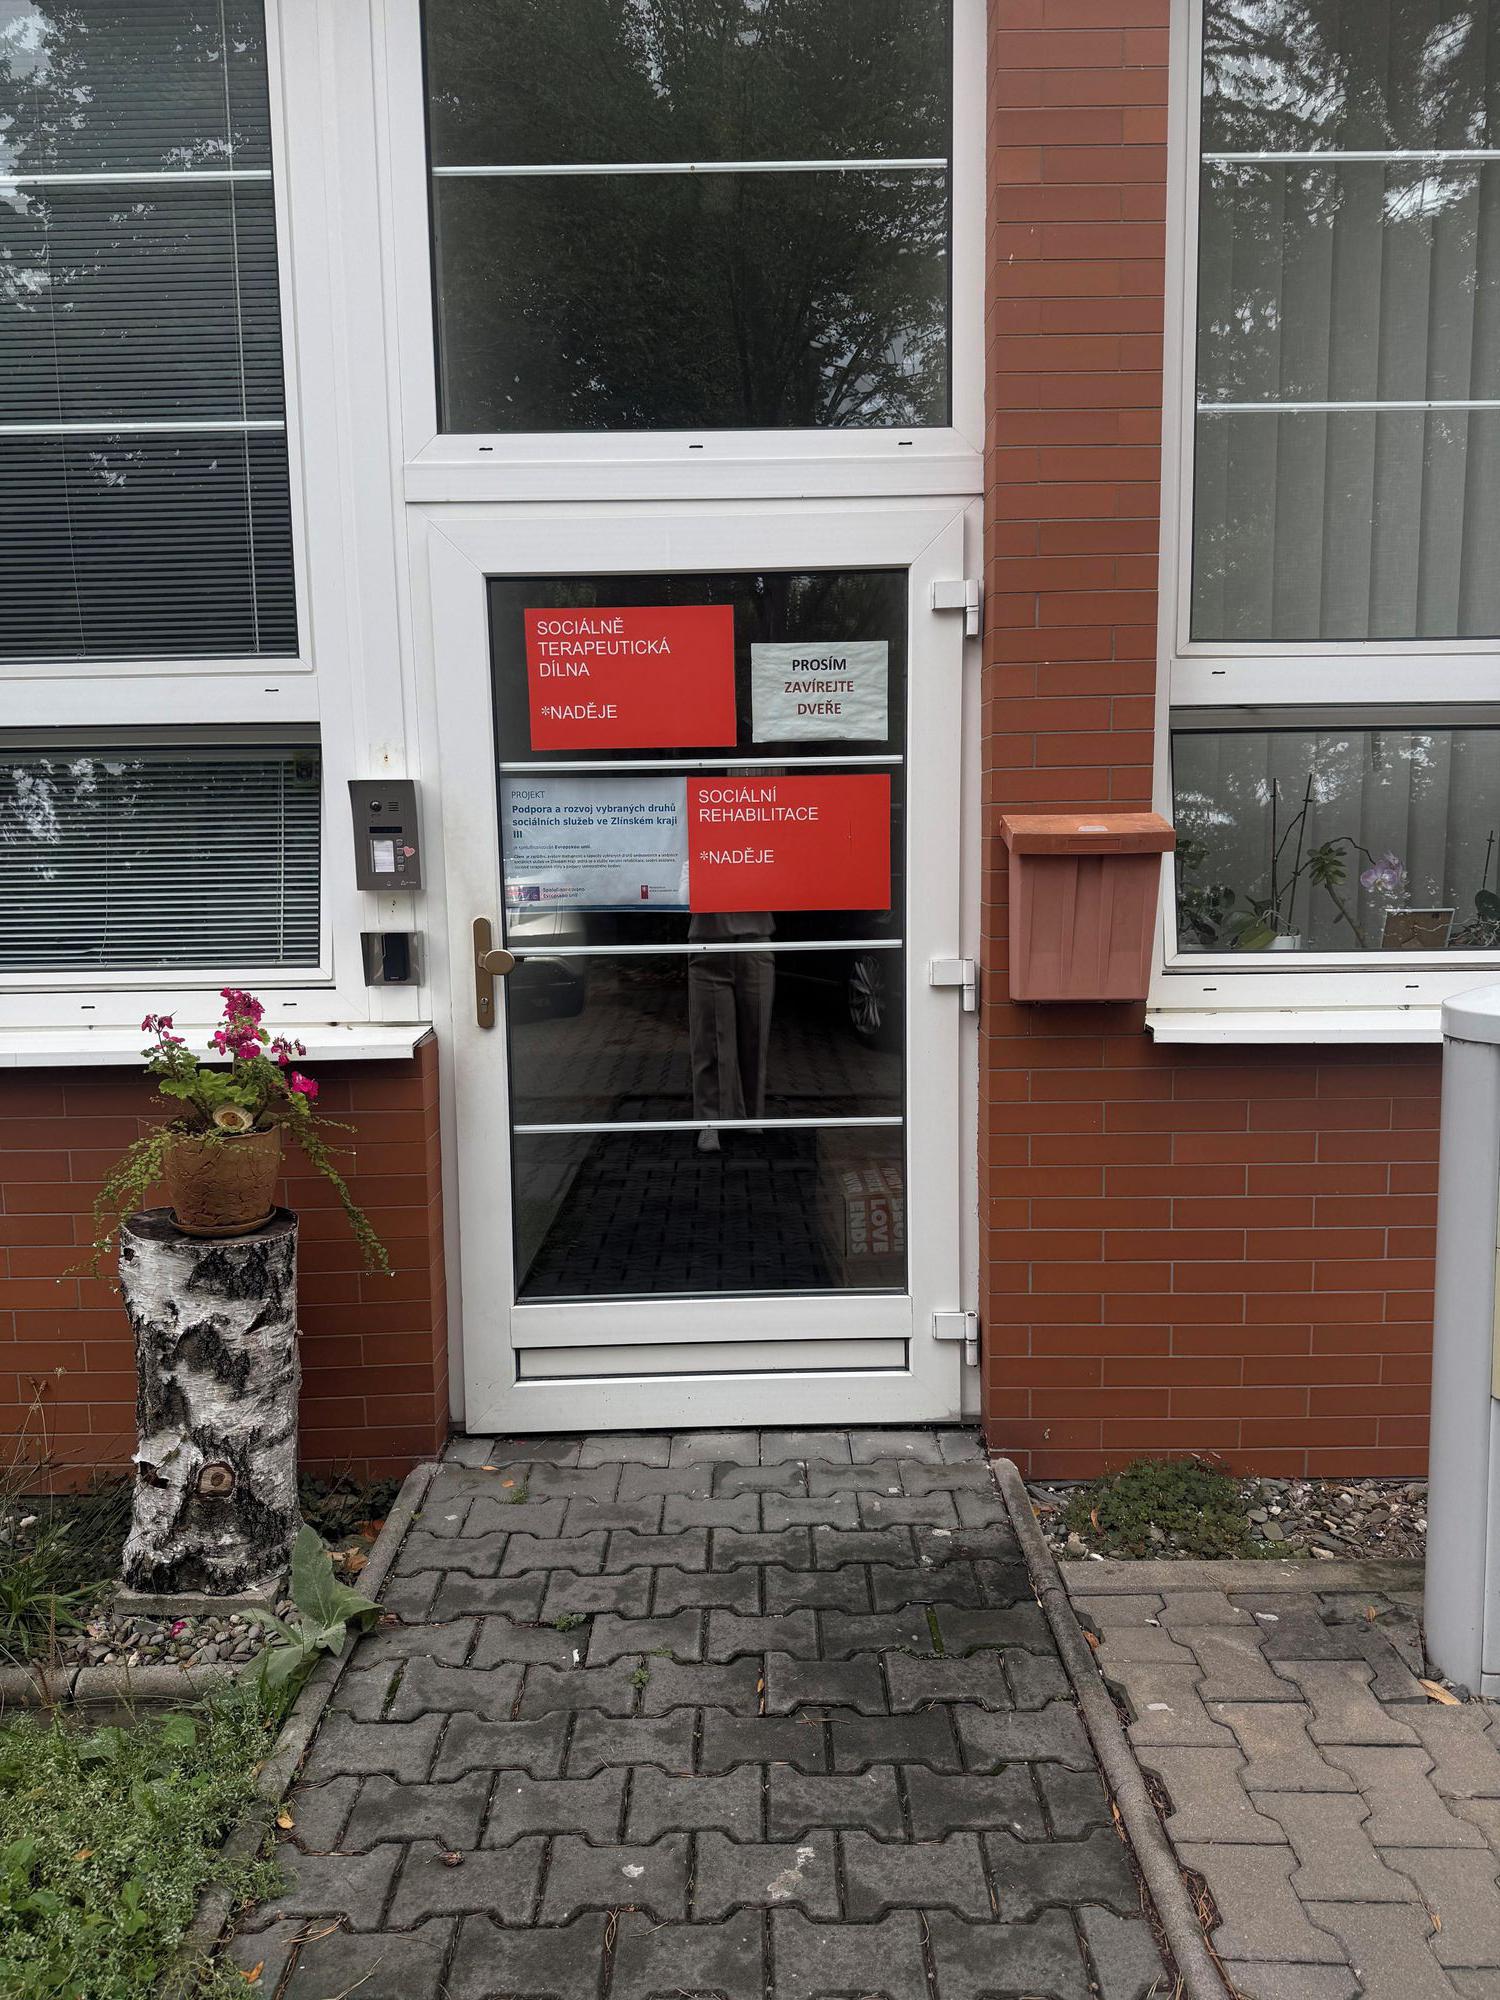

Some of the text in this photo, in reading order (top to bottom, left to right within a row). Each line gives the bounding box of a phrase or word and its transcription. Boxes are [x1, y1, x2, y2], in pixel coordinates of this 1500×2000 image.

[537, 617, 624, 635] SOCIÁLNĚ
[537, 637, 671, 656] TERAPEUTICKÁ
[539, 660, 590, 677] DÍLNA
[792, 656, 847, 671] PROSÍM
[784, 678, 854, 693] ZAVÍREJTE
[797, 700, 842, 715] DVEŘE
[511, 791, 545, 800] PROJEKT
[699, 786, 777, 803] SOCIÁLNÍ
[512, 805, 552, 816] Podpora
[564, 805, 593, 814] rozvoj
[596, 803, 645, 815] vybraných
[648, 802, 676, 812] druhů
[699, 807, 819, 822] REHABILITACE
[512, 817, 560, 826] sociálních
[563, 816, 594, 825] služeb
[657, 816, 677, 826] kraji
[513, 830, 523, 839] III
[849, 1200, 868, 1254] ENDS
[870, 1199, 889, 1253] LOVE
